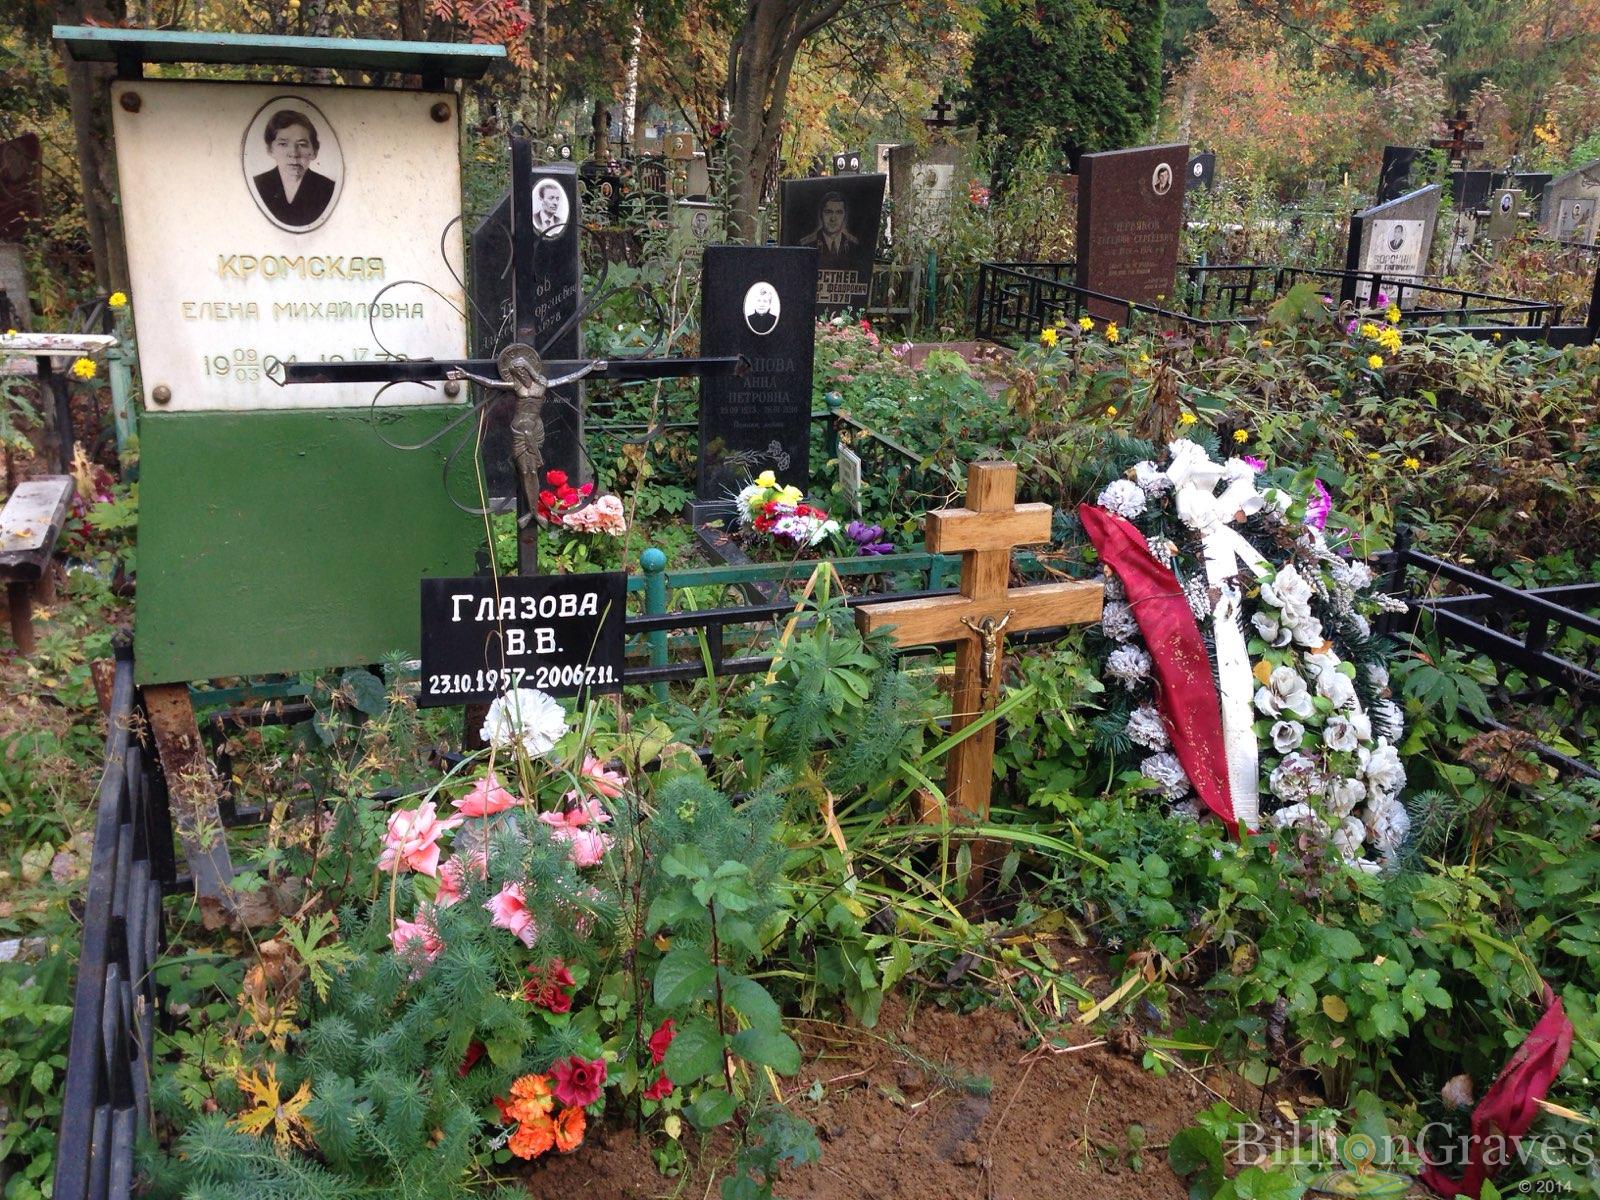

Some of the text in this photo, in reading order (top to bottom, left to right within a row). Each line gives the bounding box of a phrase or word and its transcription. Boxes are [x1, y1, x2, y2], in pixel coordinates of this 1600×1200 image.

[218, 254, 386, 280] КРОМСКАЯ
[182, 301, 424, 321] ЕЛЕНА МИХАЙЛОВНА
[506, 627, 564, 656] В.В.
